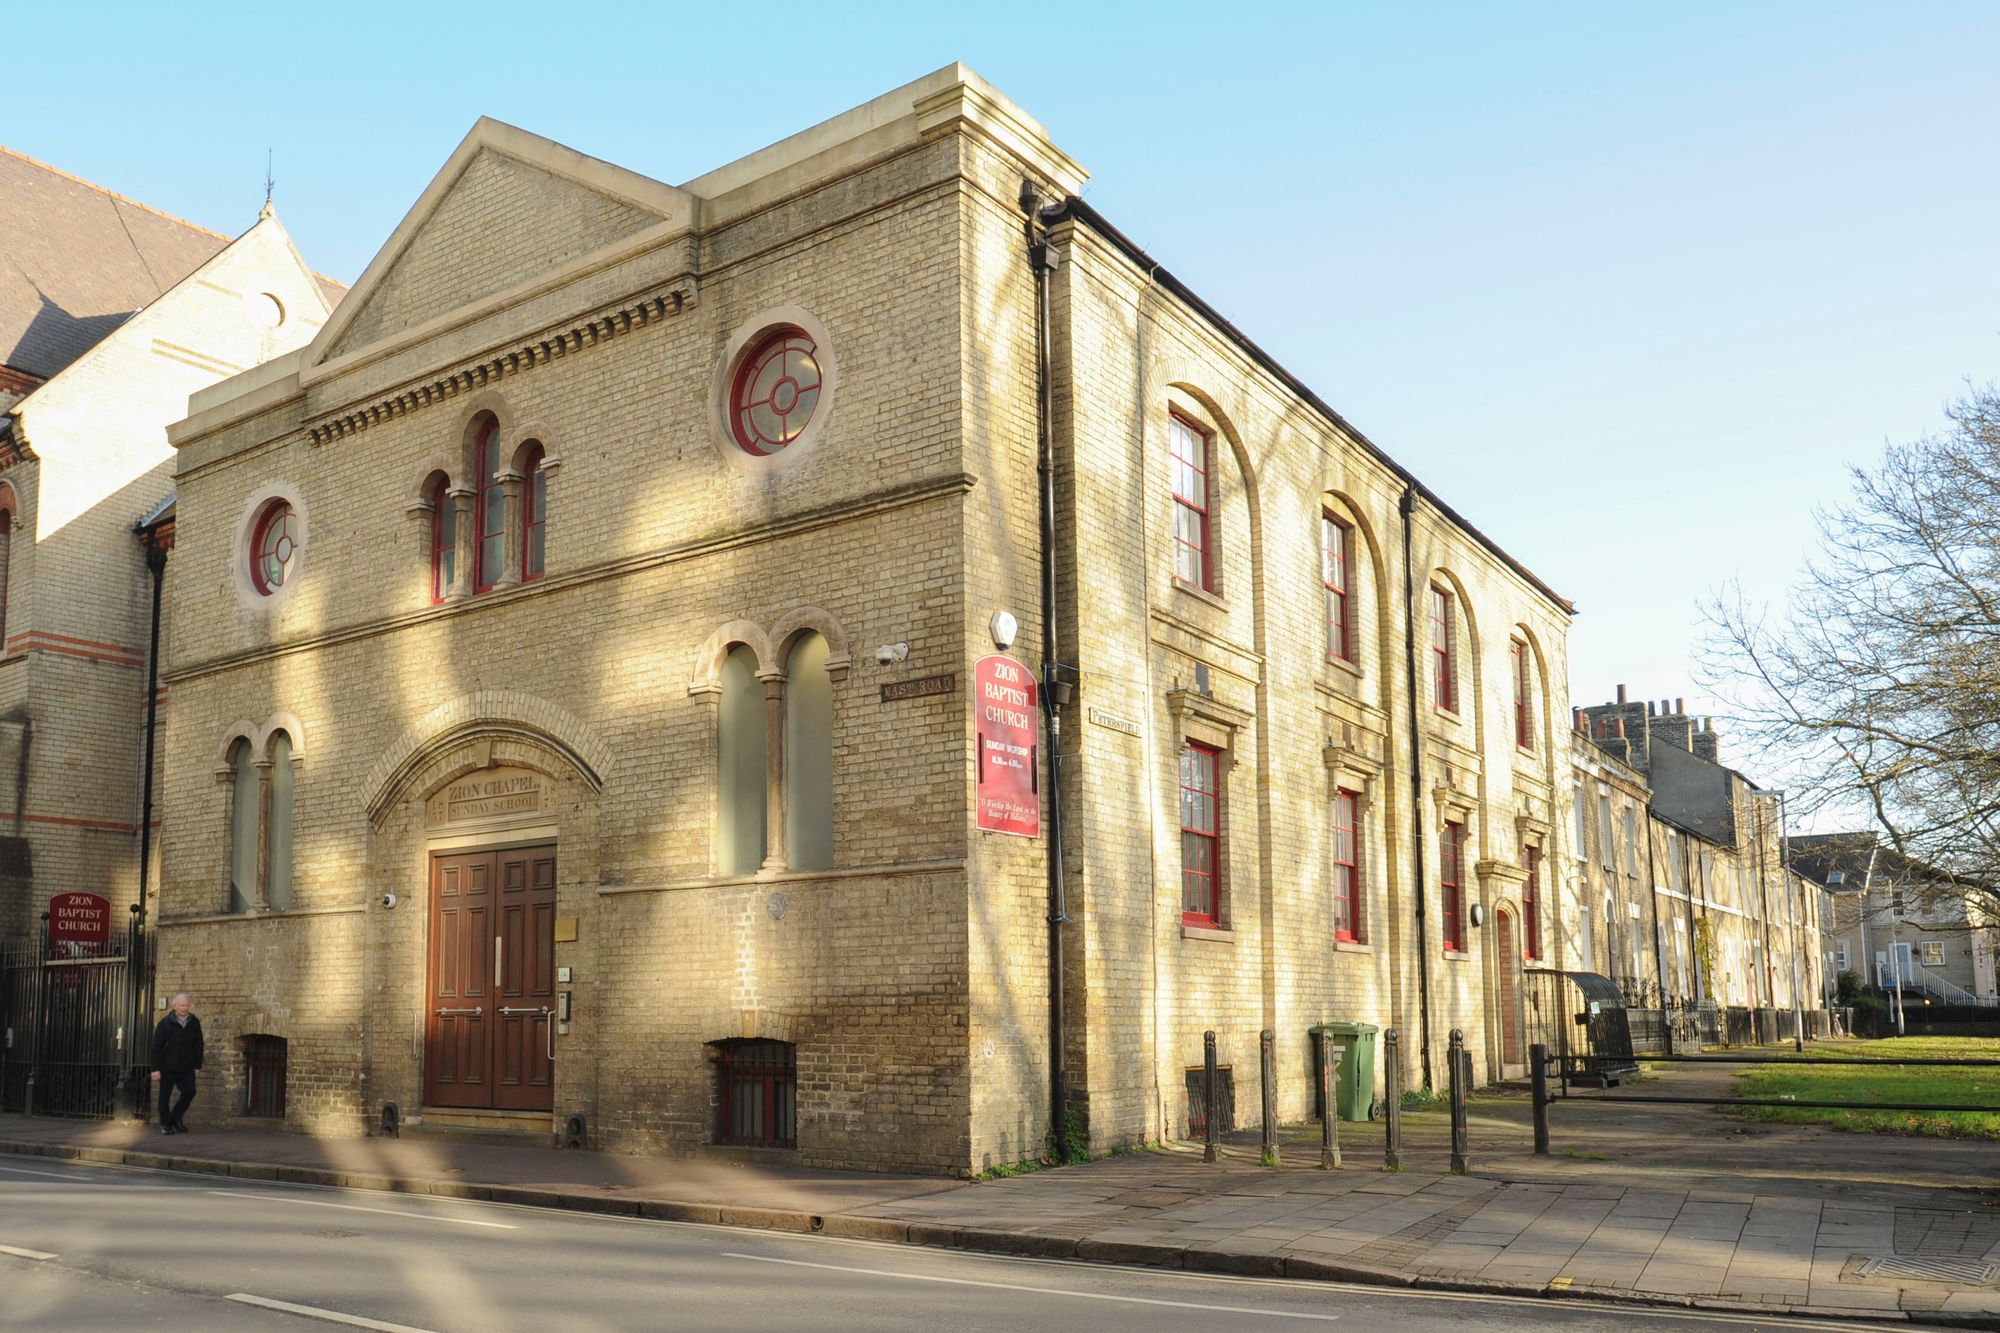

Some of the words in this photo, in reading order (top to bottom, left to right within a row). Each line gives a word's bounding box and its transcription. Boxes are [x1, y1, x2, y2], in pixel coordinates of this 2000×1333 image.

[995, 662, 1019, 683] ZION
[884, 682, 914, 697] EAST
[919, 678, 950, 693] ROAD
[985, 681, 1029, 707] BAPTIST
[986, 705, 1028, 730] CHURCH
[1092, 709, 1140, 736] PETERSFIELD
[986, 739, 1006, 752] SUNDAY
[1006, 743, 1029, 757] WORSHIP
[449, 784, 481, 801] ZION
[451, 802, 489, 817] SUNDAY
[69, 896, 93, 906] ZION
[58, 907, 102, 919] BAPTIST
[58, 920, 101, 932] CHURCH
